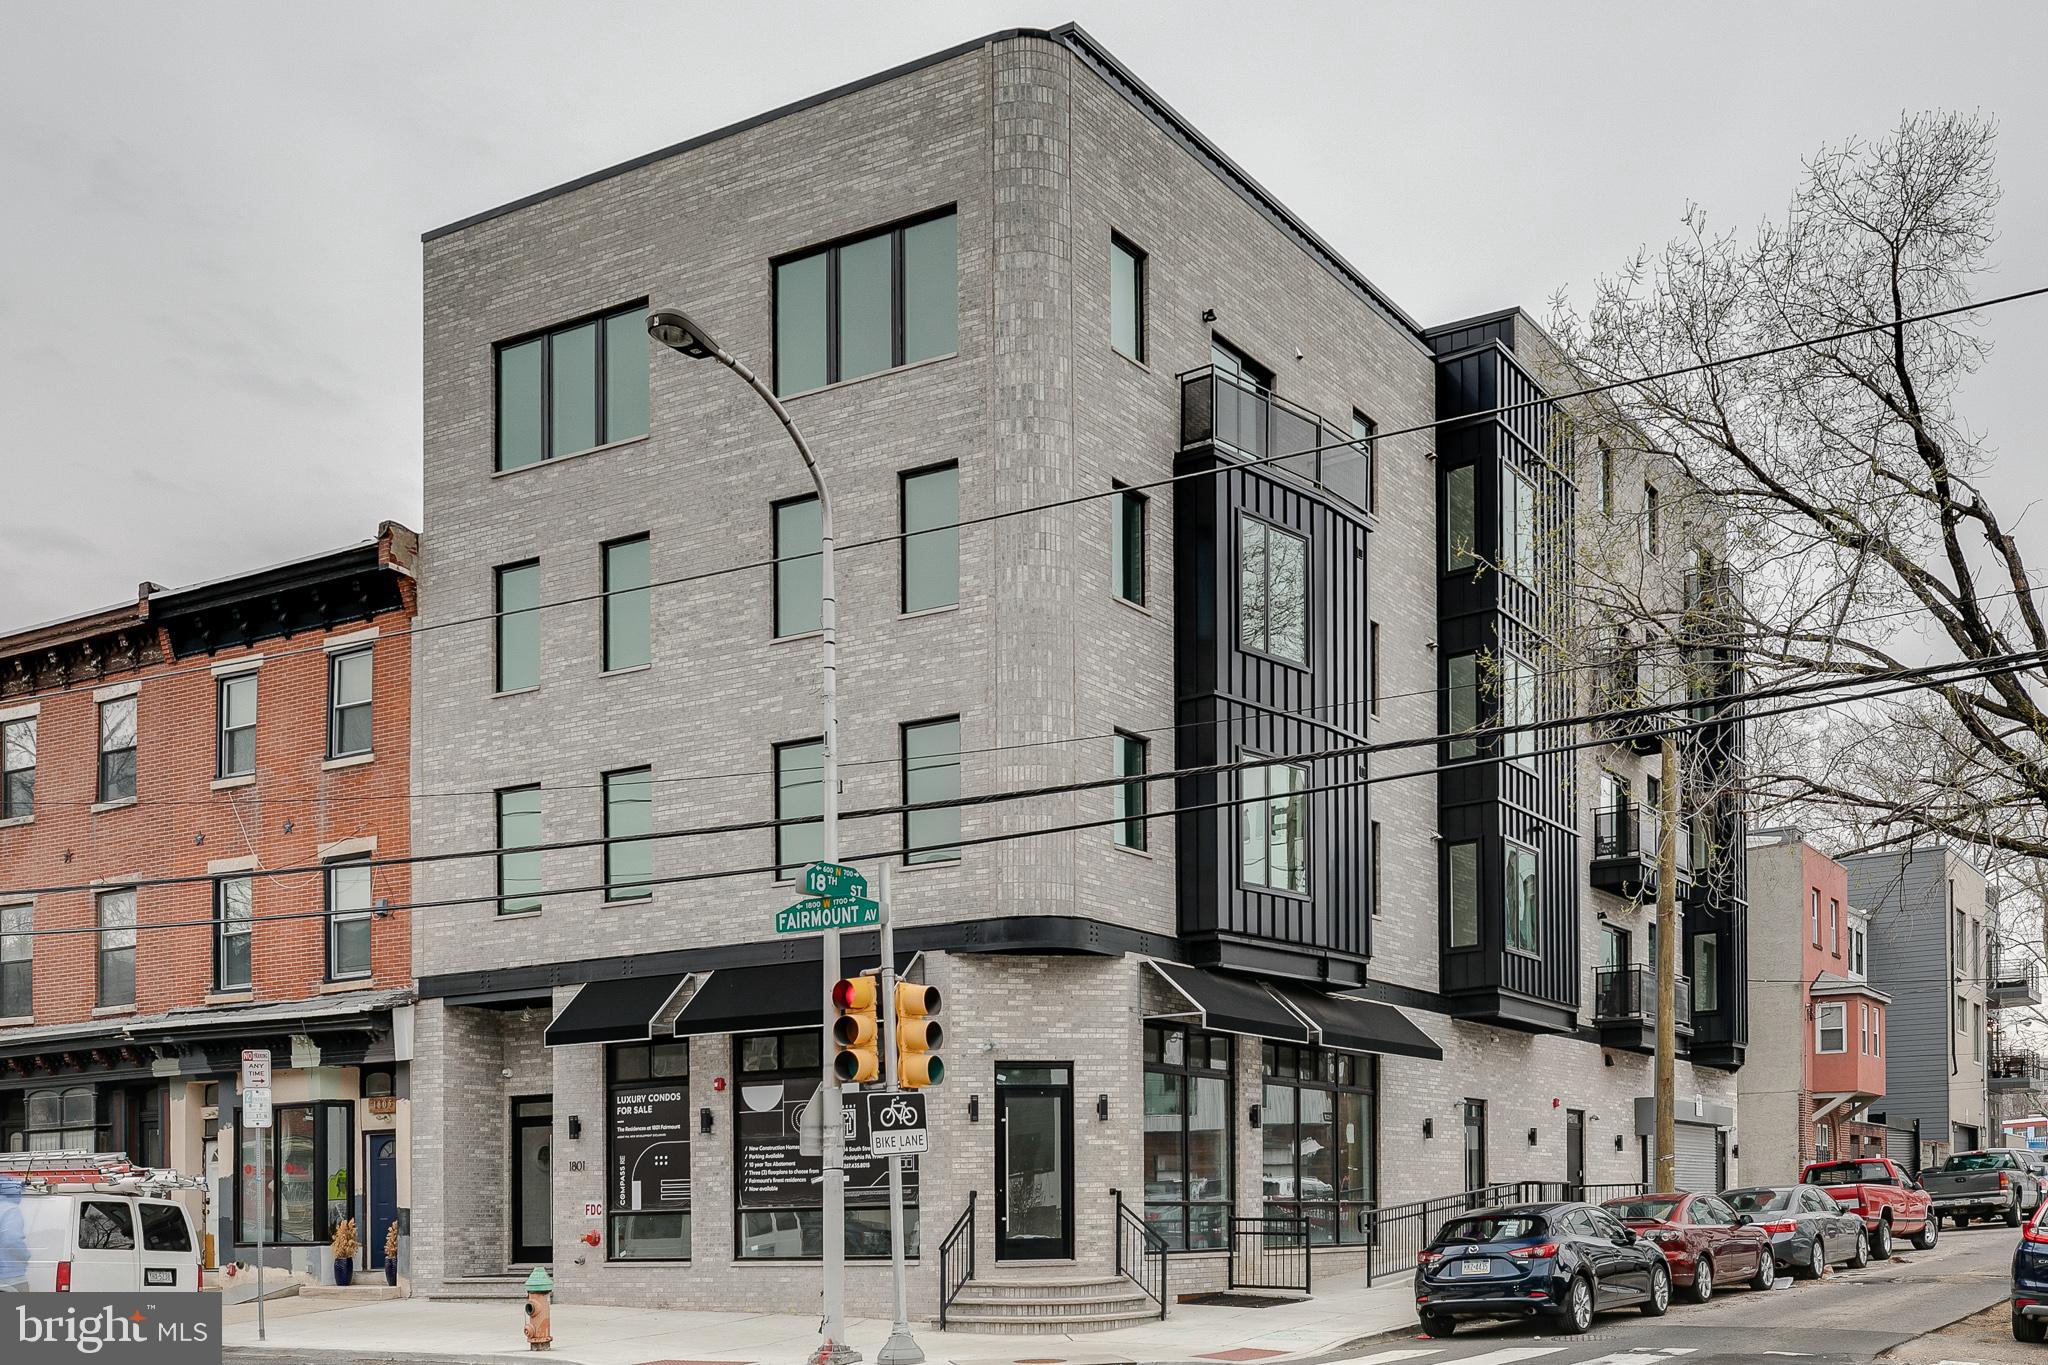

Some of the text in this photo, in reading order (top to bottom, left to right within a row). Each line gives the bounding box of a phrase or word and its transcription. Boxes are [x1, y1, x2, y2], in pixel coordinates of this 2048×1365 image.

[823, 866, 833, 874] 600
[850, 885, 862, 897] ST
[823, 898, 830, 909] W
[779, 906, 876, 930] FAIRMOUNT AV
[244, 1052, 253, 1060] NO
[617, 1092, 681, 1104] LUXURY CONDOS
[617, 1105, 652, 1115] FOR SALE
[876, 1135, 923, 1148] BIKE LANE
[569, 1161, 585, 1172] 1801
[585, 1204, 602, 1215] FDC
